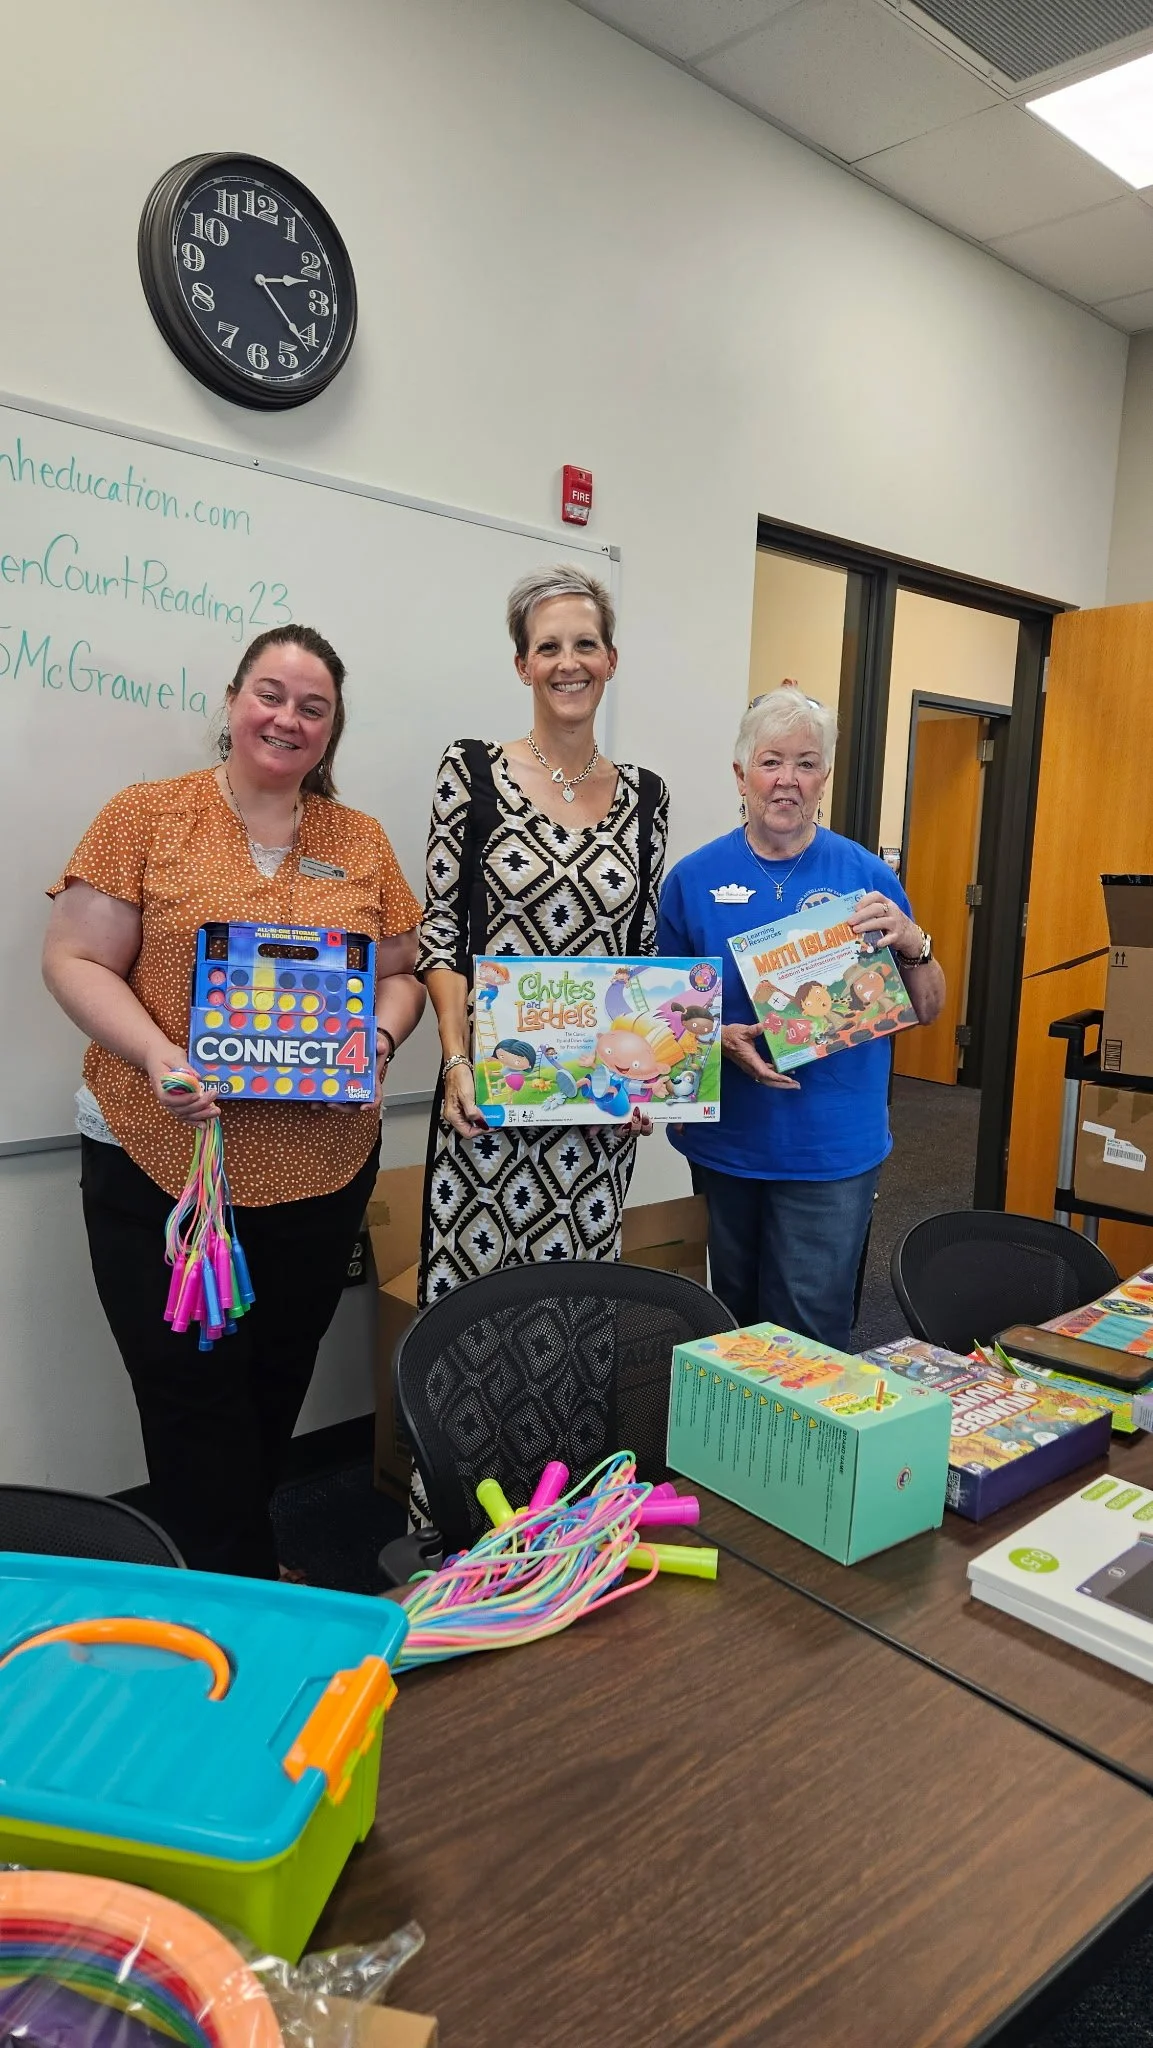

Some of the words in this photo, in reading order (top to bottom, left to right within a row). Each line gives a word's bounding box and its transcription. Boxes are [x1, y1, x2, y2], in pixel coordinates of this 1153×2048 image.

[213, 188, 242, 222] 11
[241, 189, 279, 226] 12
[190, 212, 230, 247] 10
[283, 216, 299, 244] 1
[181, 242, 206, 272] 9
[300, 251, 321, 281] 2
[191, 282, 215, 312] 8
[308, 289, 329, 317] 3
[217, 321, 240, 349] 7
[298, 322, 319, 348] 4
[246, 343, 270, 370] 6
[277, 340, 299, 369] 5
[572, 490, 590, 504] FIRE
[746, 926, 775, 939] Learning
[748, 931, 782, 946] Resources
[752, 942, 801, 977] MATH
[518, 971, 596, 1006] Chutes
[514, 999, 598, 1032] Ladders
[526, 1001, 541, 1009] and
[196, 1036, 339, 1066] CONNECT
[335, 1031, 370, 1074] 4
[703, 1106, 716, 1115] MB
